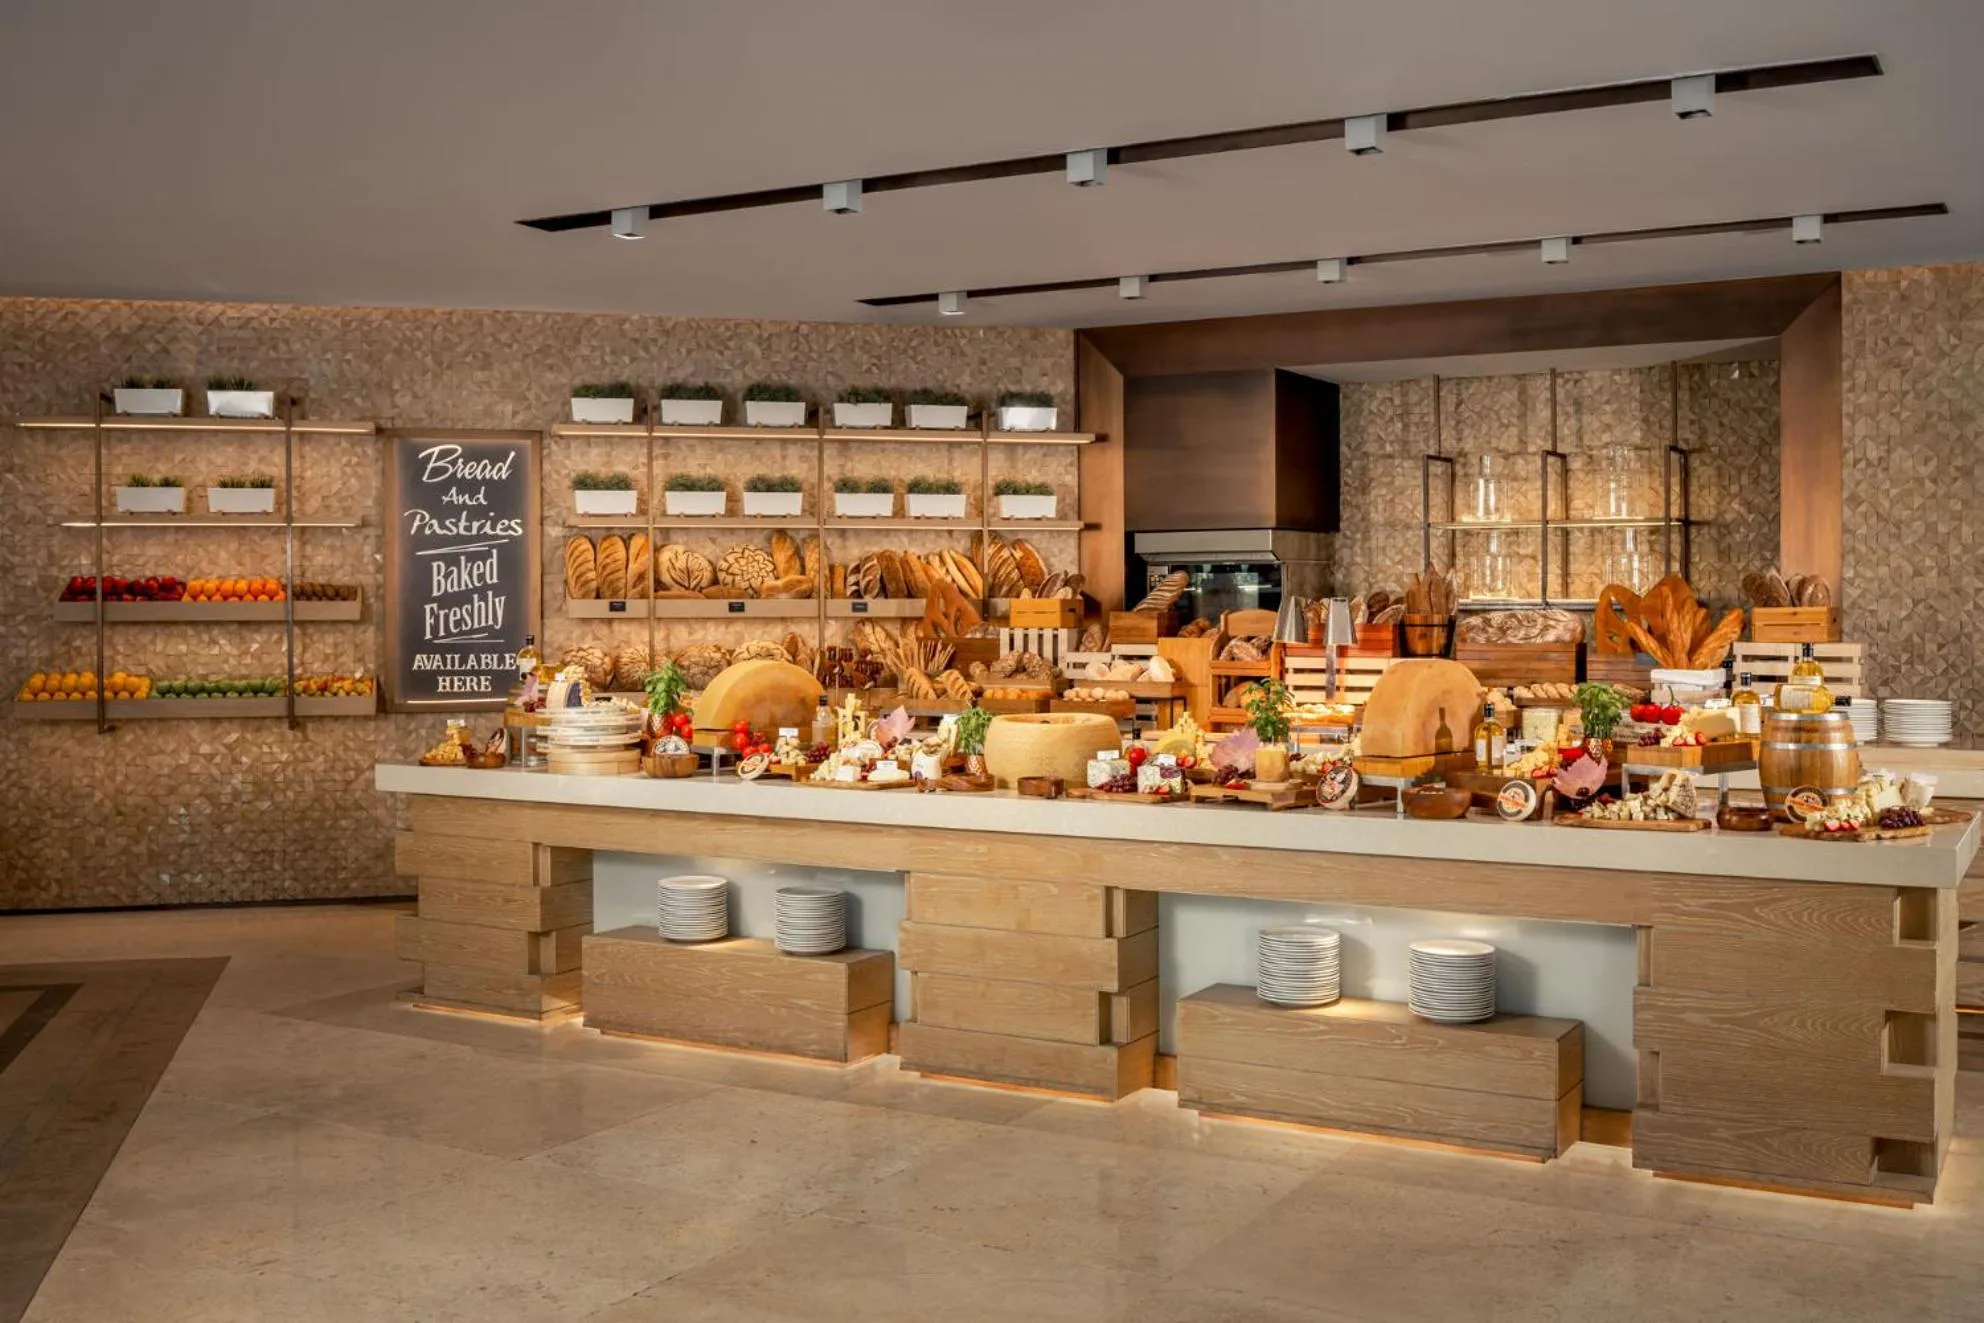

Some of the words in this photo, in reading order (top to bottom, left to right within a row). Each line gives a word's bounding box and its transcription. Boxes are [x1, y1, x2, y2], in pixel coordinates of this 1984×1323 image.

[418, 443, 516, 483] Bread
[441, 486, 488, 505] And
[403, 508, 524, 537] Pastries
[431, 549, 499, 597] Baked
[424, 590, 506, 641] Freshly
[412, 653, 518, 671] AVAILABLE
[436, 675, 492, 693] HERE
